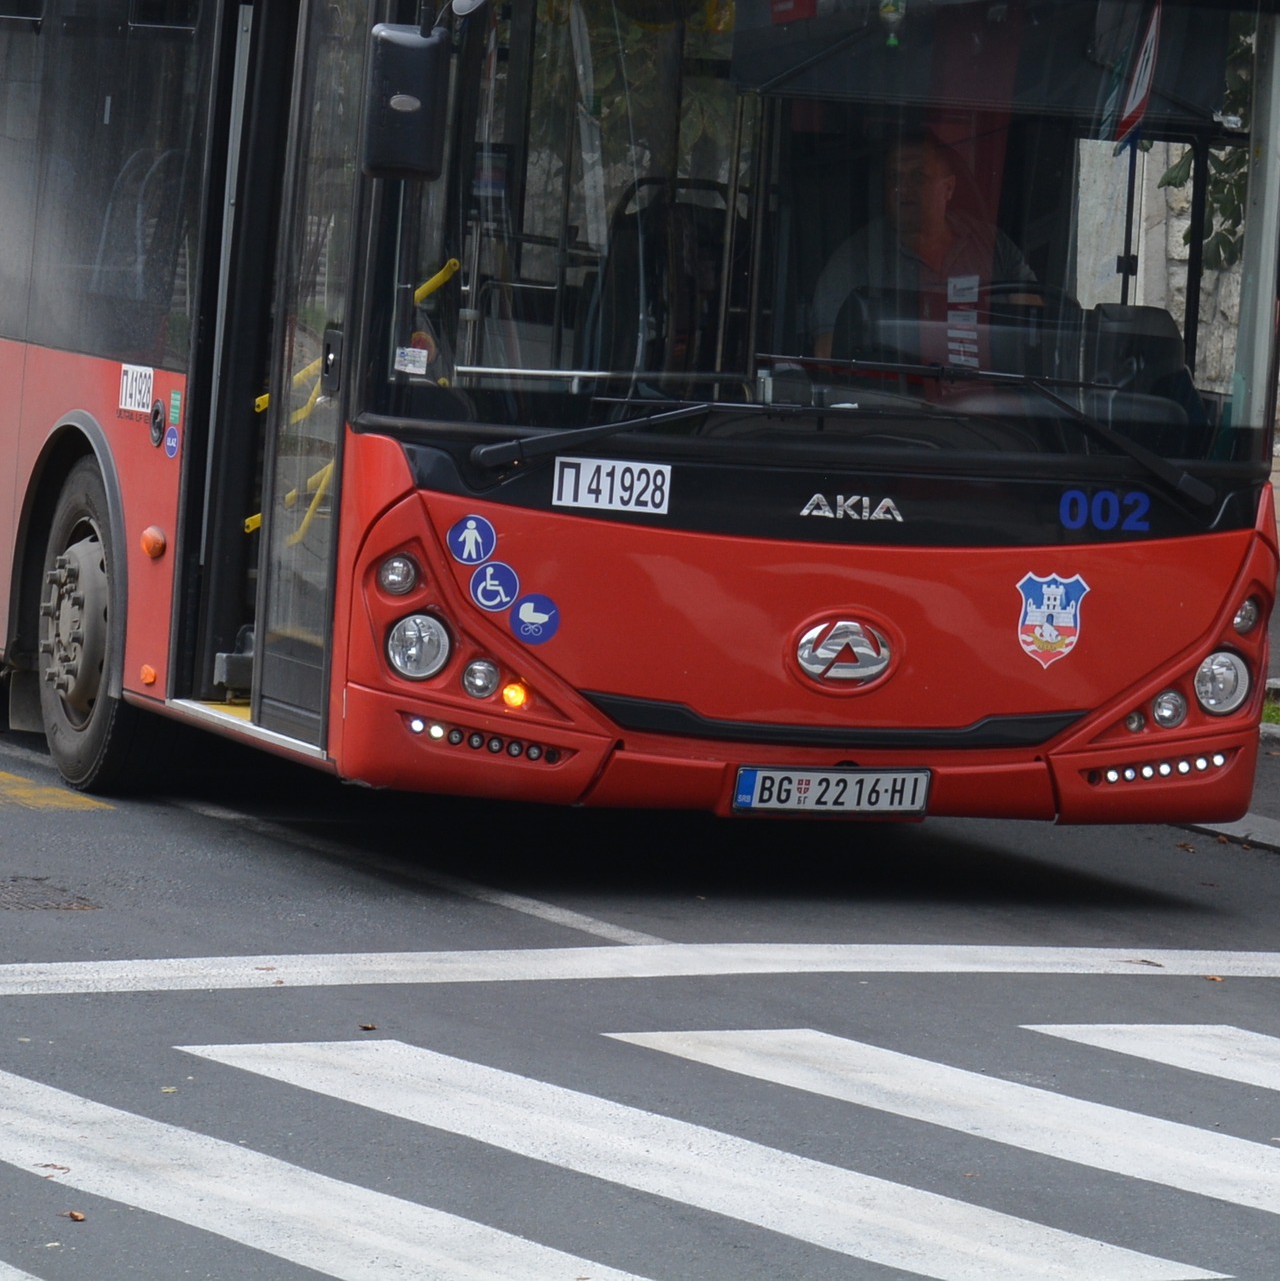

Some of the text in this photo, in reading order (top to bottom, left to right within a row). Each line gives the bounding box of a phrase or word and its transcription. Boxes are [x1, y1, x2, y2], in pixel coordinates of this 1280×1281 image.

[586, 464, 666, 509] 41928
[799, 493, 904, 522] AKIA
[1059, 489, 1151, 531] 002
[736, 794, 752, 803] SRB
[758, 775, 793, 805] BG
